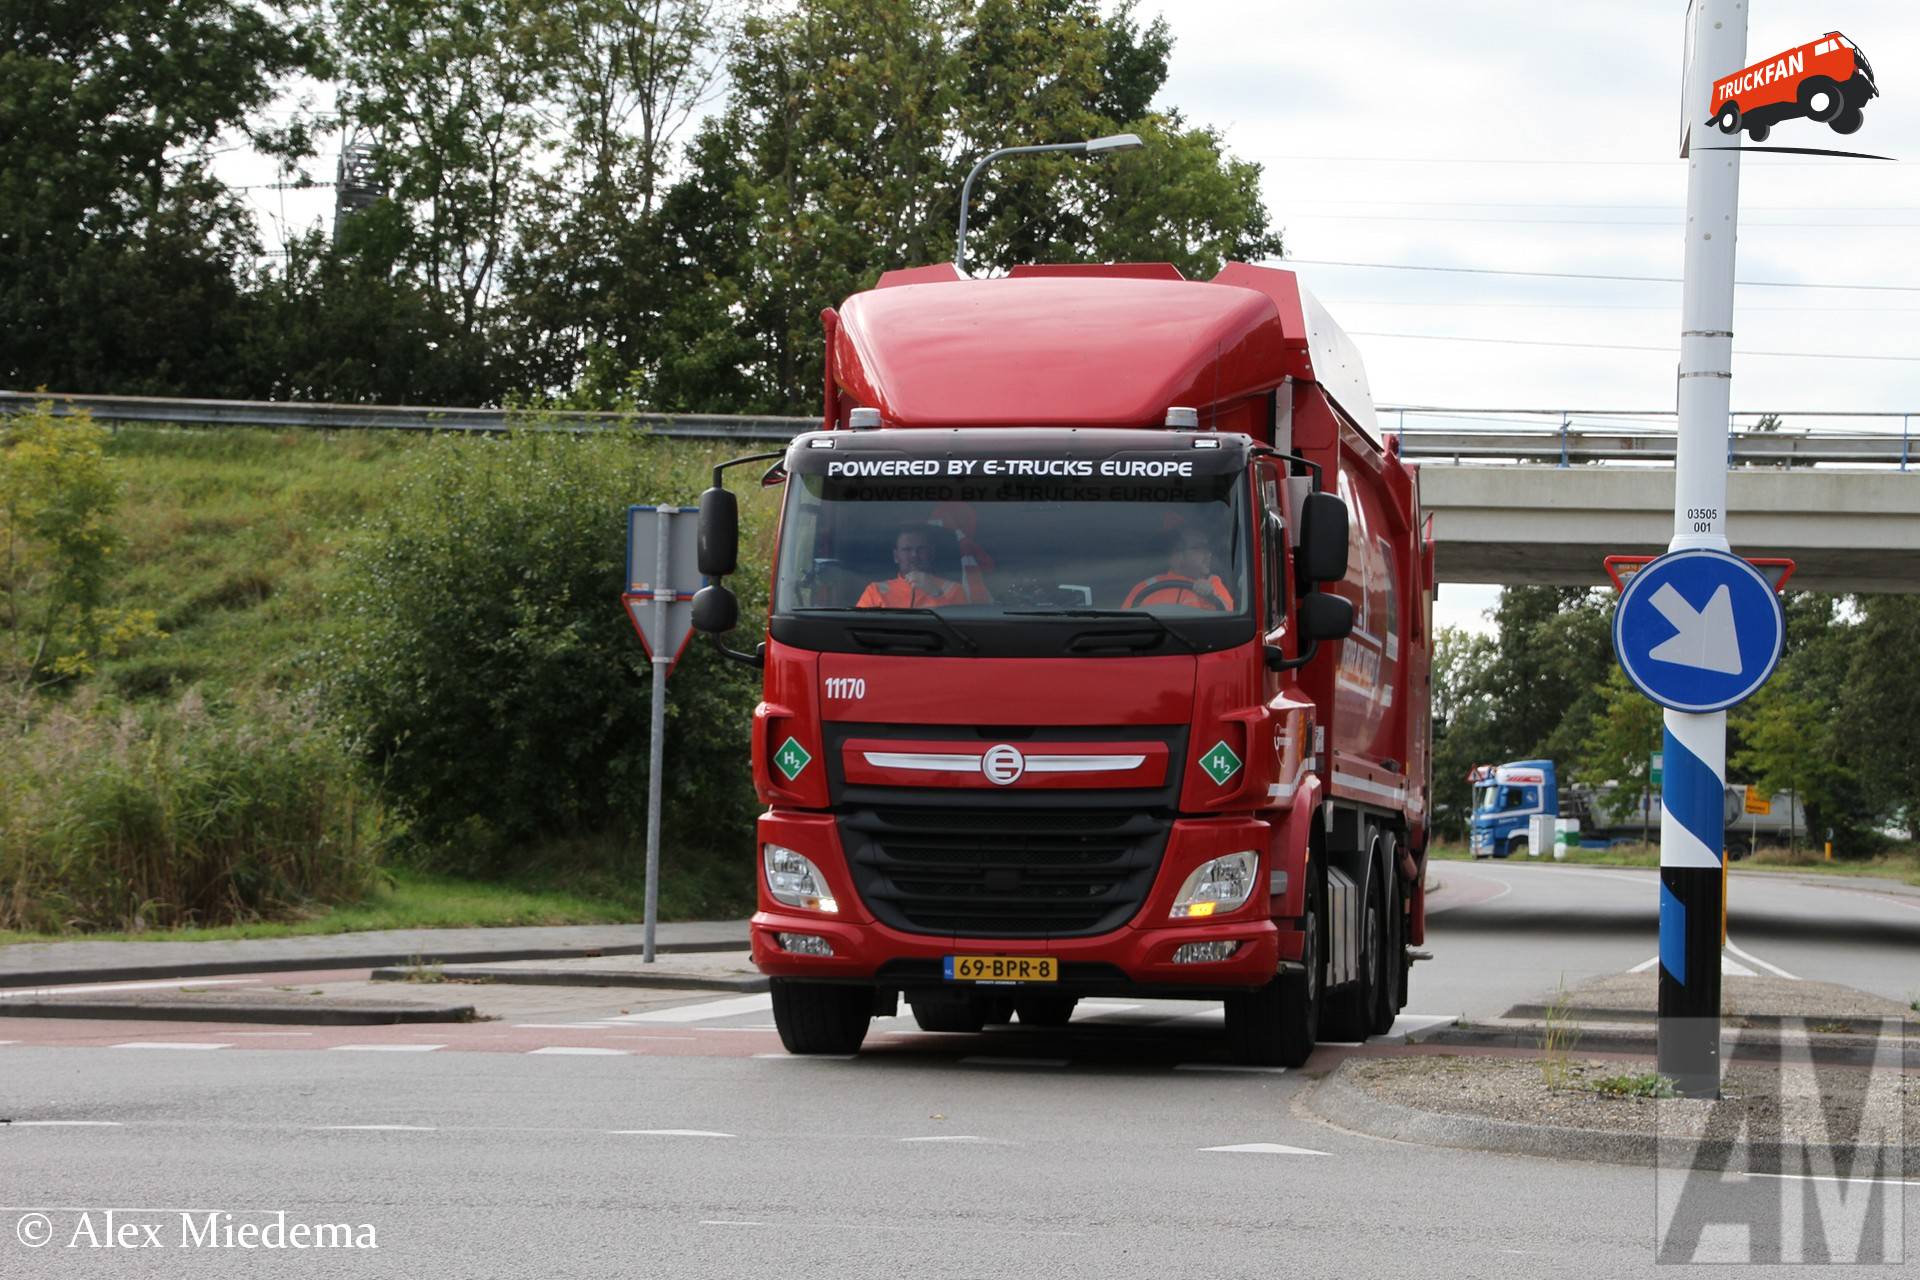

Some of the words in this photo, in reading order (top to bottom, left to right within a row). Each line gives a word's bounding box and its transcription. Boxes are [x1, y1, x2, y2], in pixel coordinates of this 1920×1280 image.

[828, 460, 940, 477] POWERED
[947, 460, 976, 476] BY
[983, 460, 1093, 476] E-TRUCKS
[1100, 460, 1193, 477] EUROPE
[1687, 508, 1718, 520] 03505
[1693, 521, 1711, 533] 001
[825, 677, 866, 700] 11170
[959, 959, 1050, 978] 69-BPR-8
